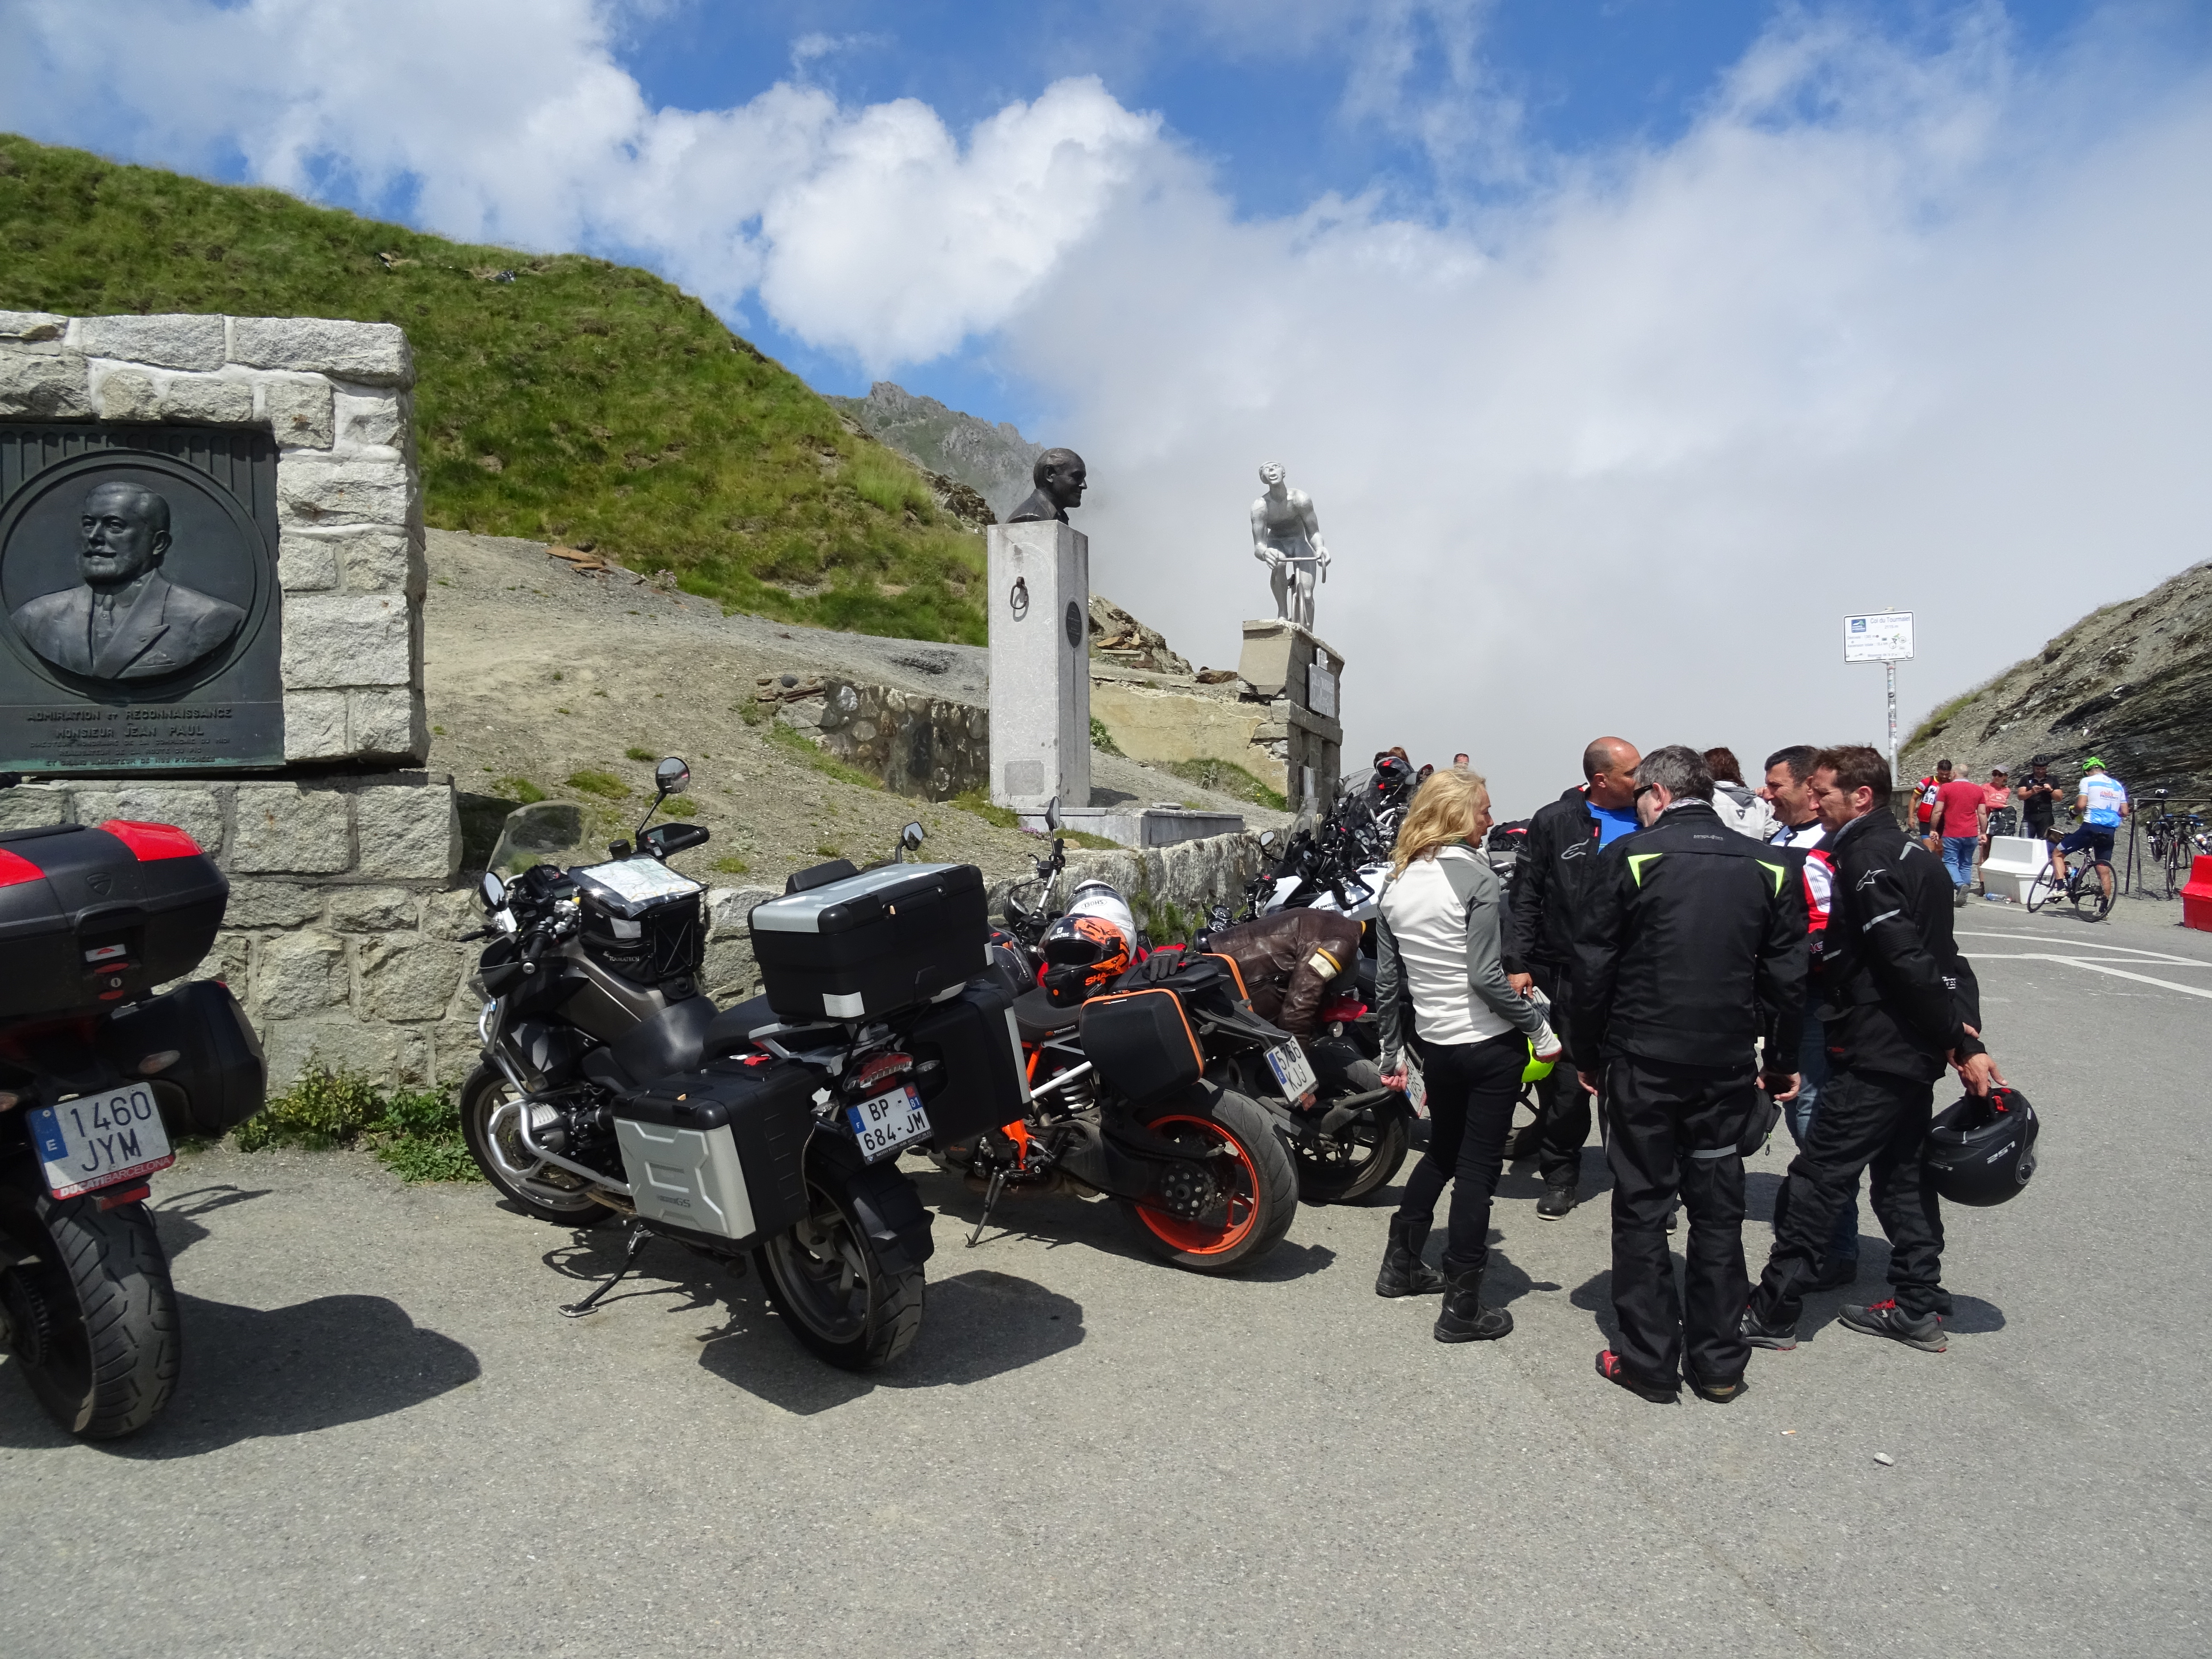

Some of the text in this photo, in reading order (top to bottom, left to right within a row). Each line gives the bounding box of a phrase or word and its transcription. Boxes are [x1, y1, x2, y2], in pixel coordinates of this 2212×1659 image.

[27, 711, 101, 722] ADMIRATION
[126, 708, 233, 720] RECONNAISSANCE
[56, 725, 204, 739] MONSIEUR JEAN PAUL
[1316, 901, 1338, 910] Kawasa
[1275, 1040, 1301, 1070] 5766
[1286, 1064, 1307, 1091] KJJ
[910, 1097, 920, 1108] 81
[71, 1091, 151, 1138] 1460
[46, 1139, 57, 1151] E
[81, 1128, 142, 1172] JYM
[876, 1149, 888, 1157] MOTO
[1986, 1141, 2016, 1164] LS2
